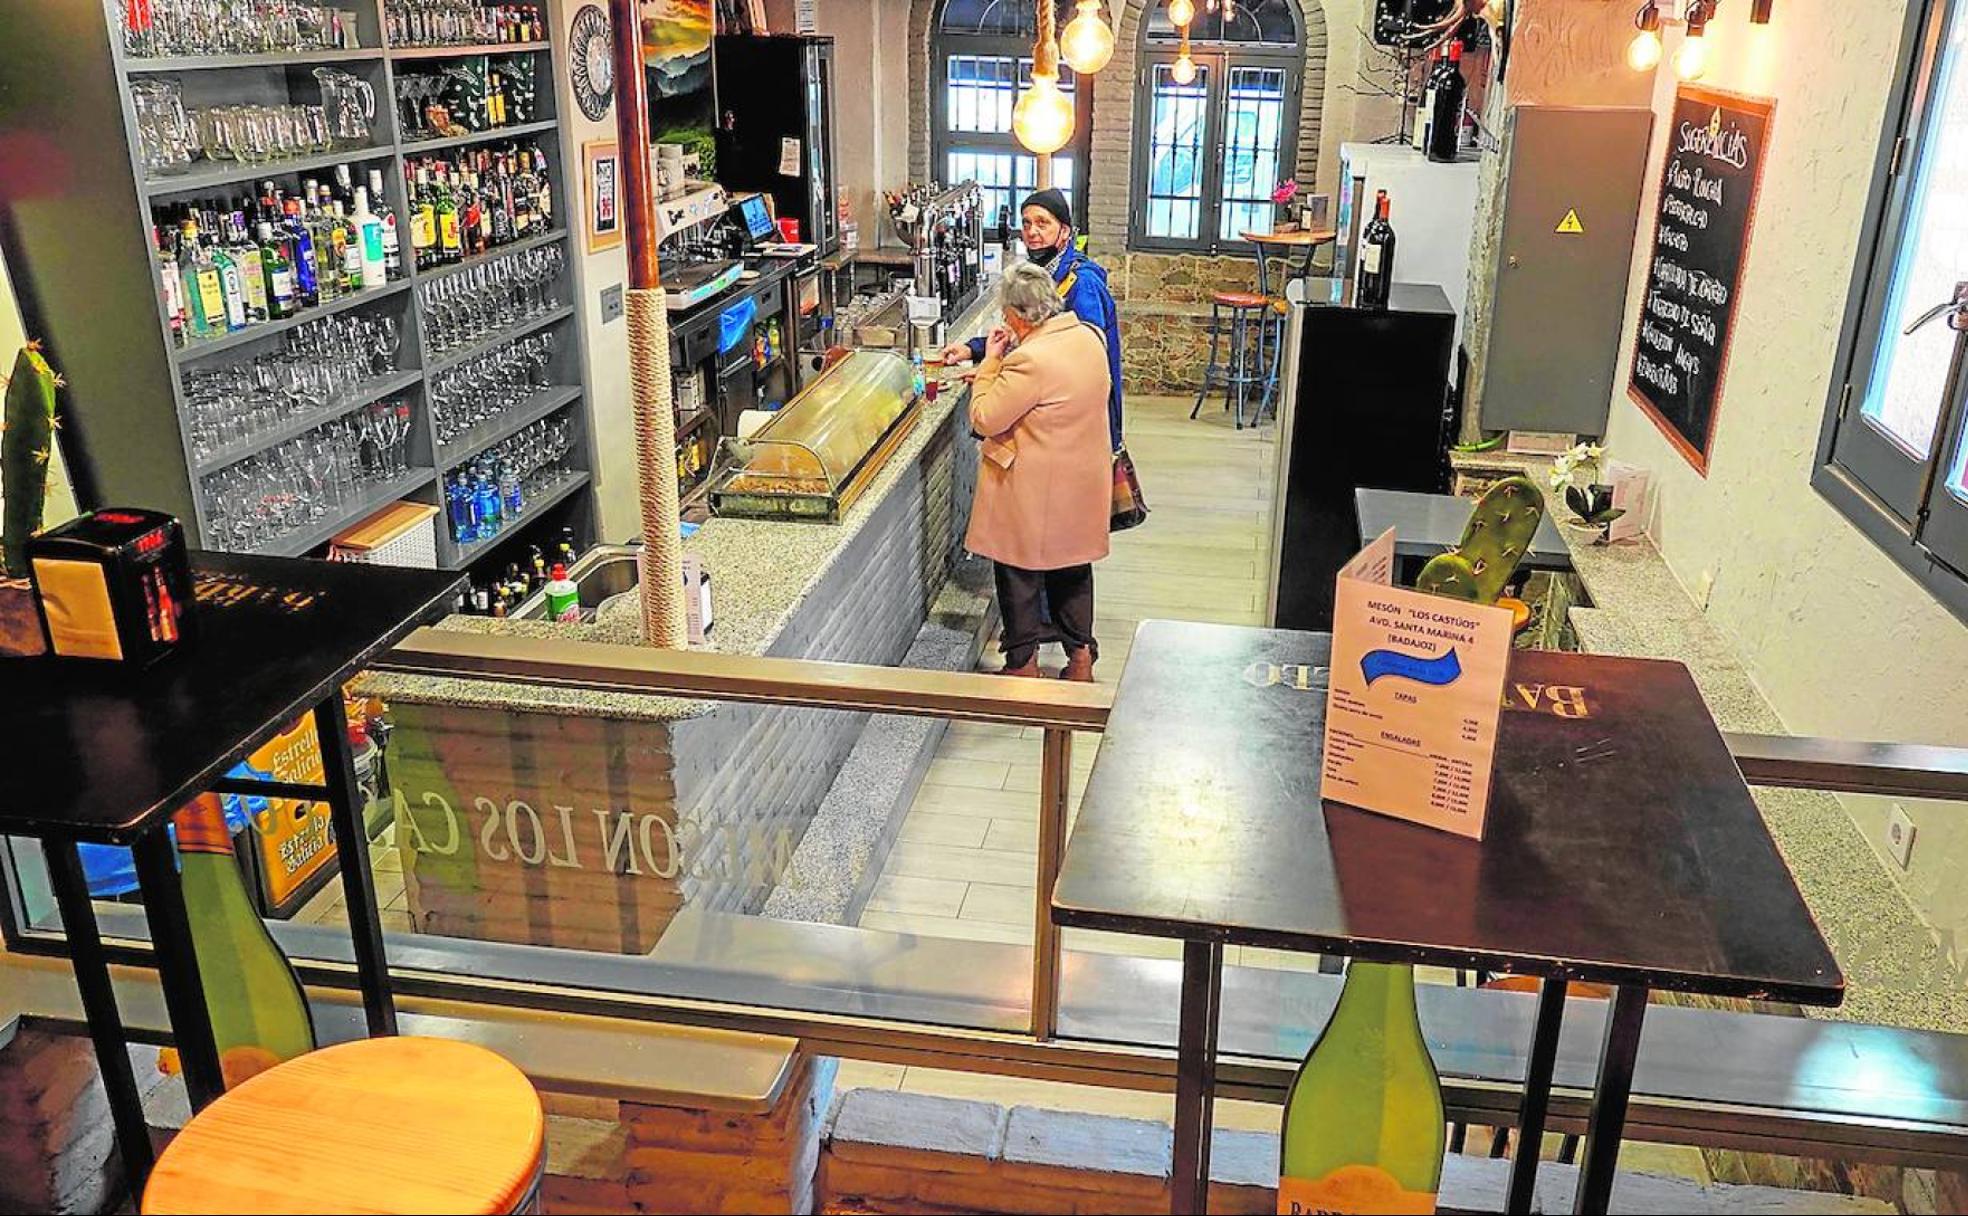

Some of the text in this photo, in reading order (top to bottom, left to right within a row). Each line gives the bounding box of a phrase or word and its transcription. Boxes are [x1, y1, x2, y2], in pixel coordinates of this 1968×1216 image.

[1367, 600, 1401, 615] MESÓN
[1394, 620, 1425, 634] SANTA
[1426, 626, 1466, 642] MARINA
